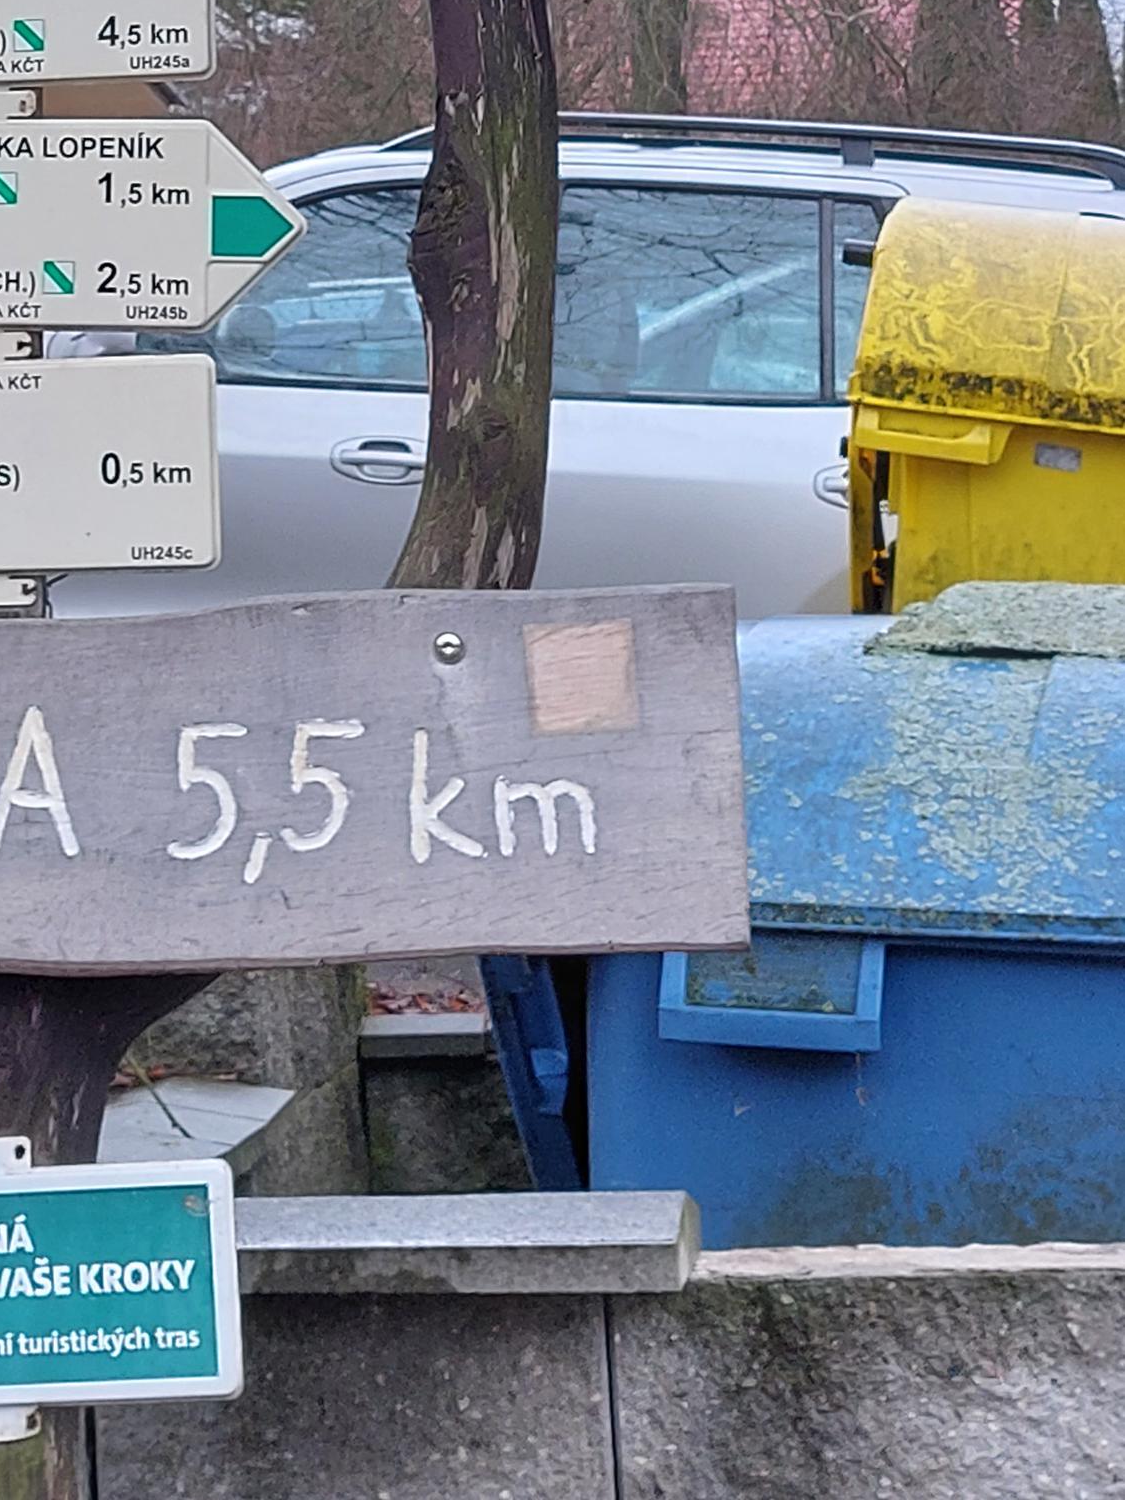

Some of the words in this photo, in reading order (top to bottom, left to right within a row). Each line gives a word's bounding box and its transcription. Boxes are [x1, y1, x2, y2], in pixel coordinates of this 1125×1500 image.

[97, 16, 141, 50] 4,5
[151, 22, 189, 45] km
[11, 57, 45, 74] KČT
[129, 55, 190, 71] UH245a
[42, 131, 164, 160] LOPENÍK
[99, 173, 143, 207] 1,5
[152, 181, 190, 205] km
[97, 263, 142, 297] 2,5
[151, 274, 189, 295] km
[7, 301, 42, 319] KČT
[126, 305, 188, 320] UH245b
[8, 372, 41, 390] KČT
[101, 452, 143, 487] 0,5
[153, 461, 191, 485] km
[131, 545, 193, 561] UH245c
[165, 719, 368, 886] 5,5
[409, 729, 598, 865] km
[79, 1259, 195, 1295] KROKY
[18, 1326, 149, 1358] turistických
[154, 1327, 200, 1350] tras
